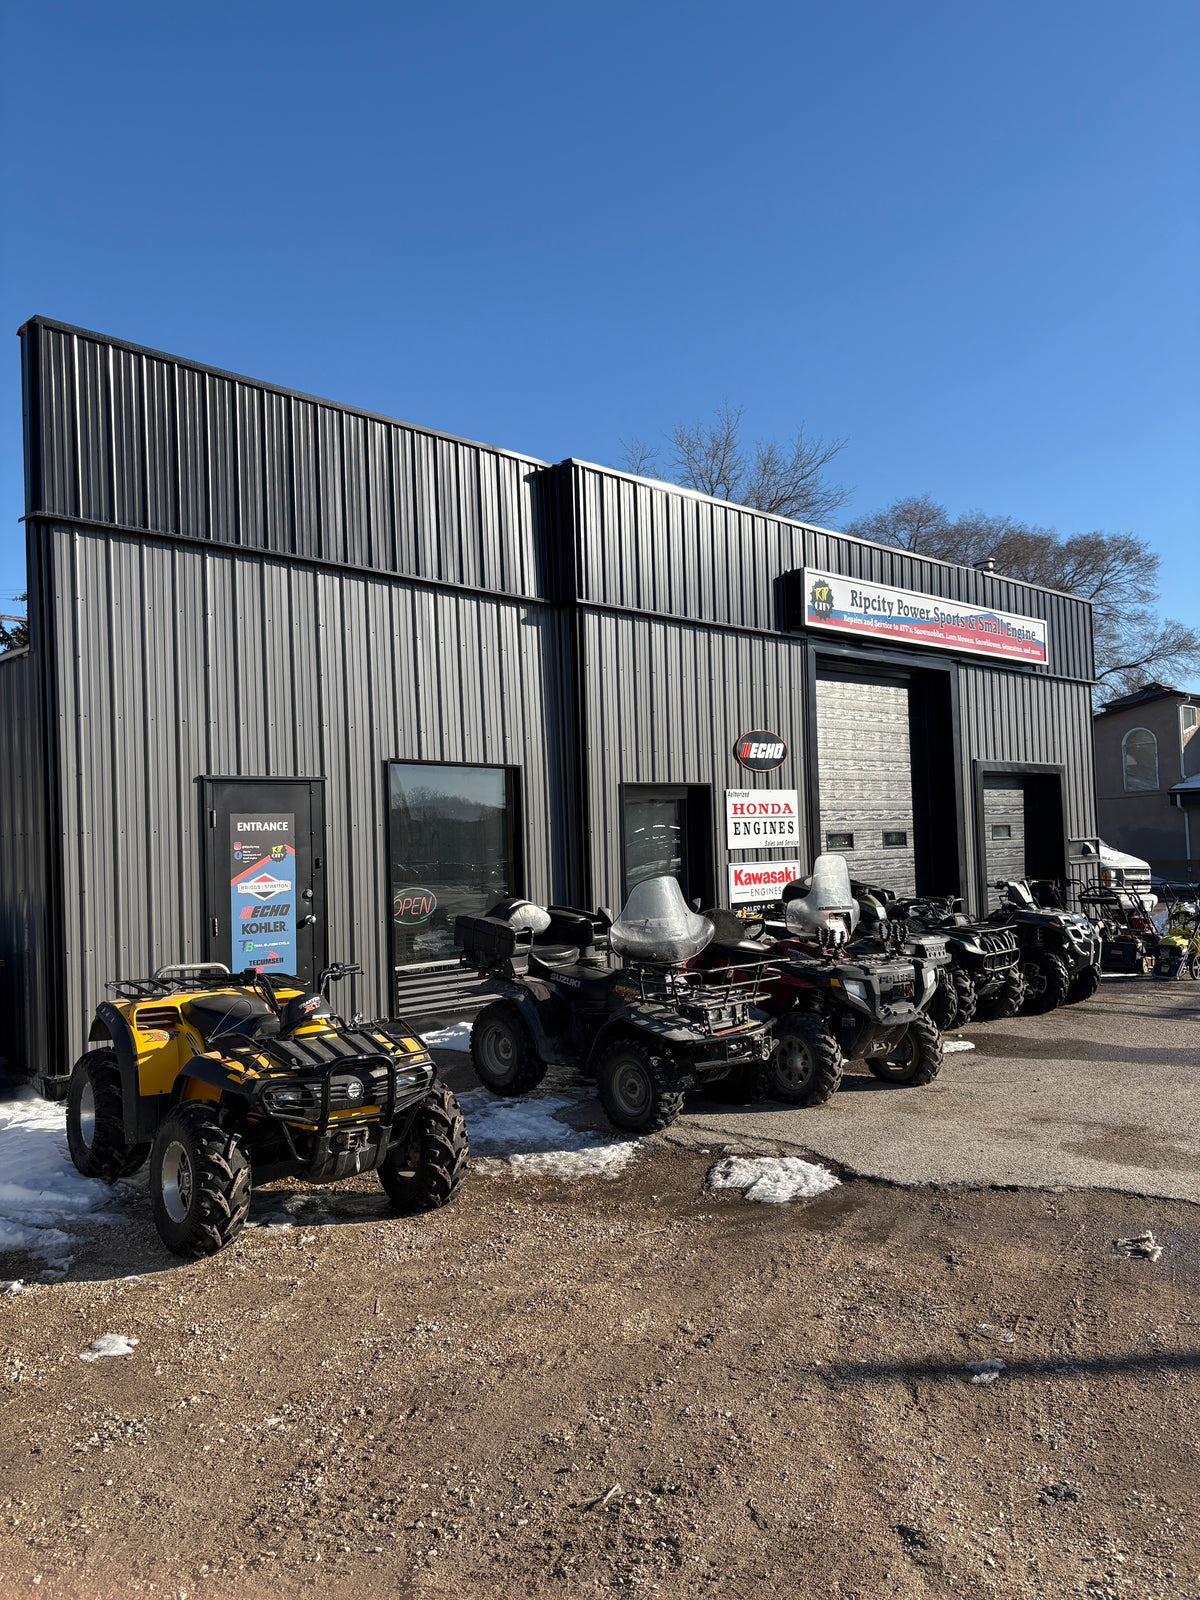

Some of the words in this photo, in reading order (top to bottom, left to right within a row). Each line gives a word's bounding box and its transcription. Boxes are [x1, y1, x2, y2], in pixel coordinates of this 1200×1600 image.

[814, 586, 828, 601] RIP
[814, 602, 830, 611] CITY
[844, 614, 863, 625] Repairs
[864, 618, 874, 626] and
[874, 620, 892, 629] Service
[850, 590, 894, 618] Ripcity
[896, 598, 930, 620] Power
[934, 606, 965, 628] Sports
[968, 614, 975, 629] &
[978, 616, 1003, 635] Small
[1006, 622, 1036, 643] Engine
[749, 743, 784, 758] ECHO
[728, 790, 749, 798] Authorized
[732, 803, 793, 815] HONDA
[237, 822, 288, 831] ENTRANCE
[734, 821, 794, 835] ENGINES
[734, 867, 796, 886] Kawasaki
[751, 887, 782, 896] ENGINES
[251, 904, 290, 918] ECHO
[394, 896, 432, 917] OPEN
[242, 921, 286, 935] KOHLER
[248, 957, 284, 966] TECUMSEH
[550, 973, 580, 988] SUZUKI
